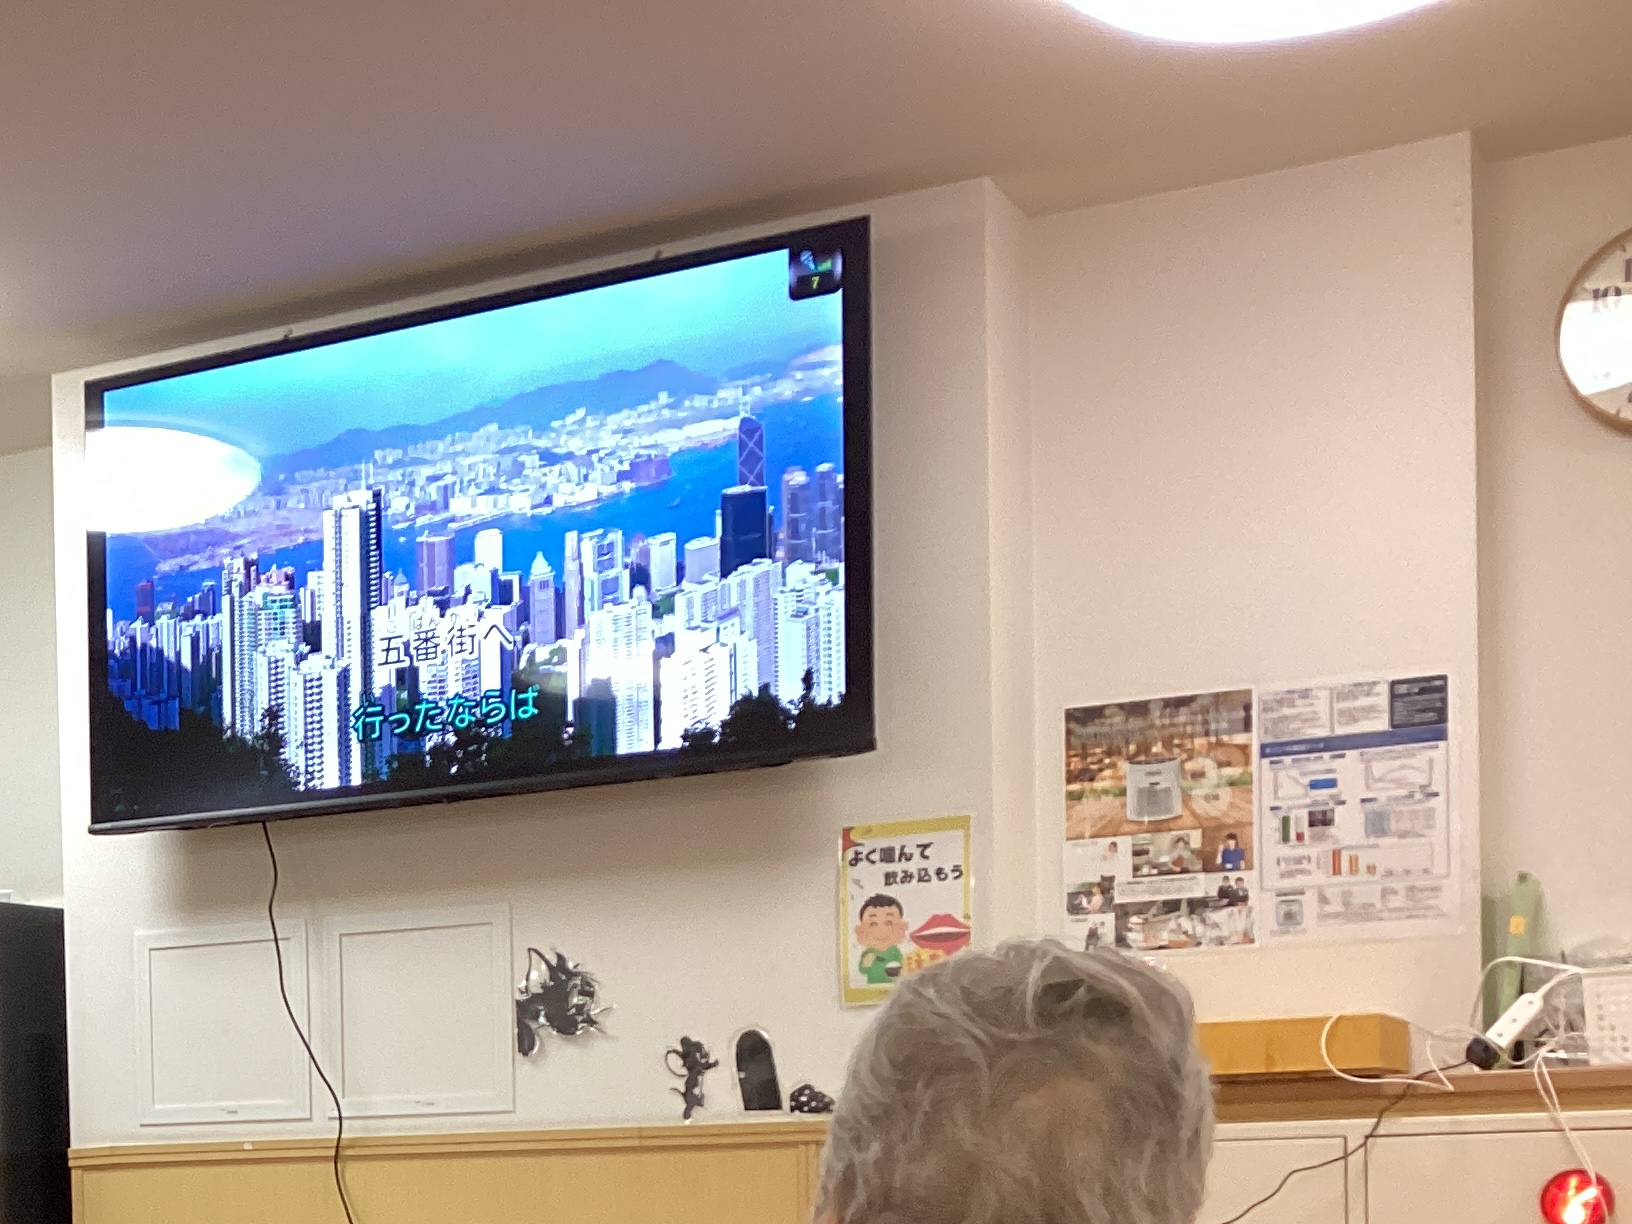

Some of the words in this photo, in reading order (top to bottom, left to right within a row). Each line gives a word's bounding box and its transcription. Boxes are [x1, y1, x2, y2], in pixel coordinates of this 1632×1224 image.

[811, 275, 821, 290] 7
[378, 624, 513, 667] 五番街へ
[353, 685, 539, 741] 行ったならば
